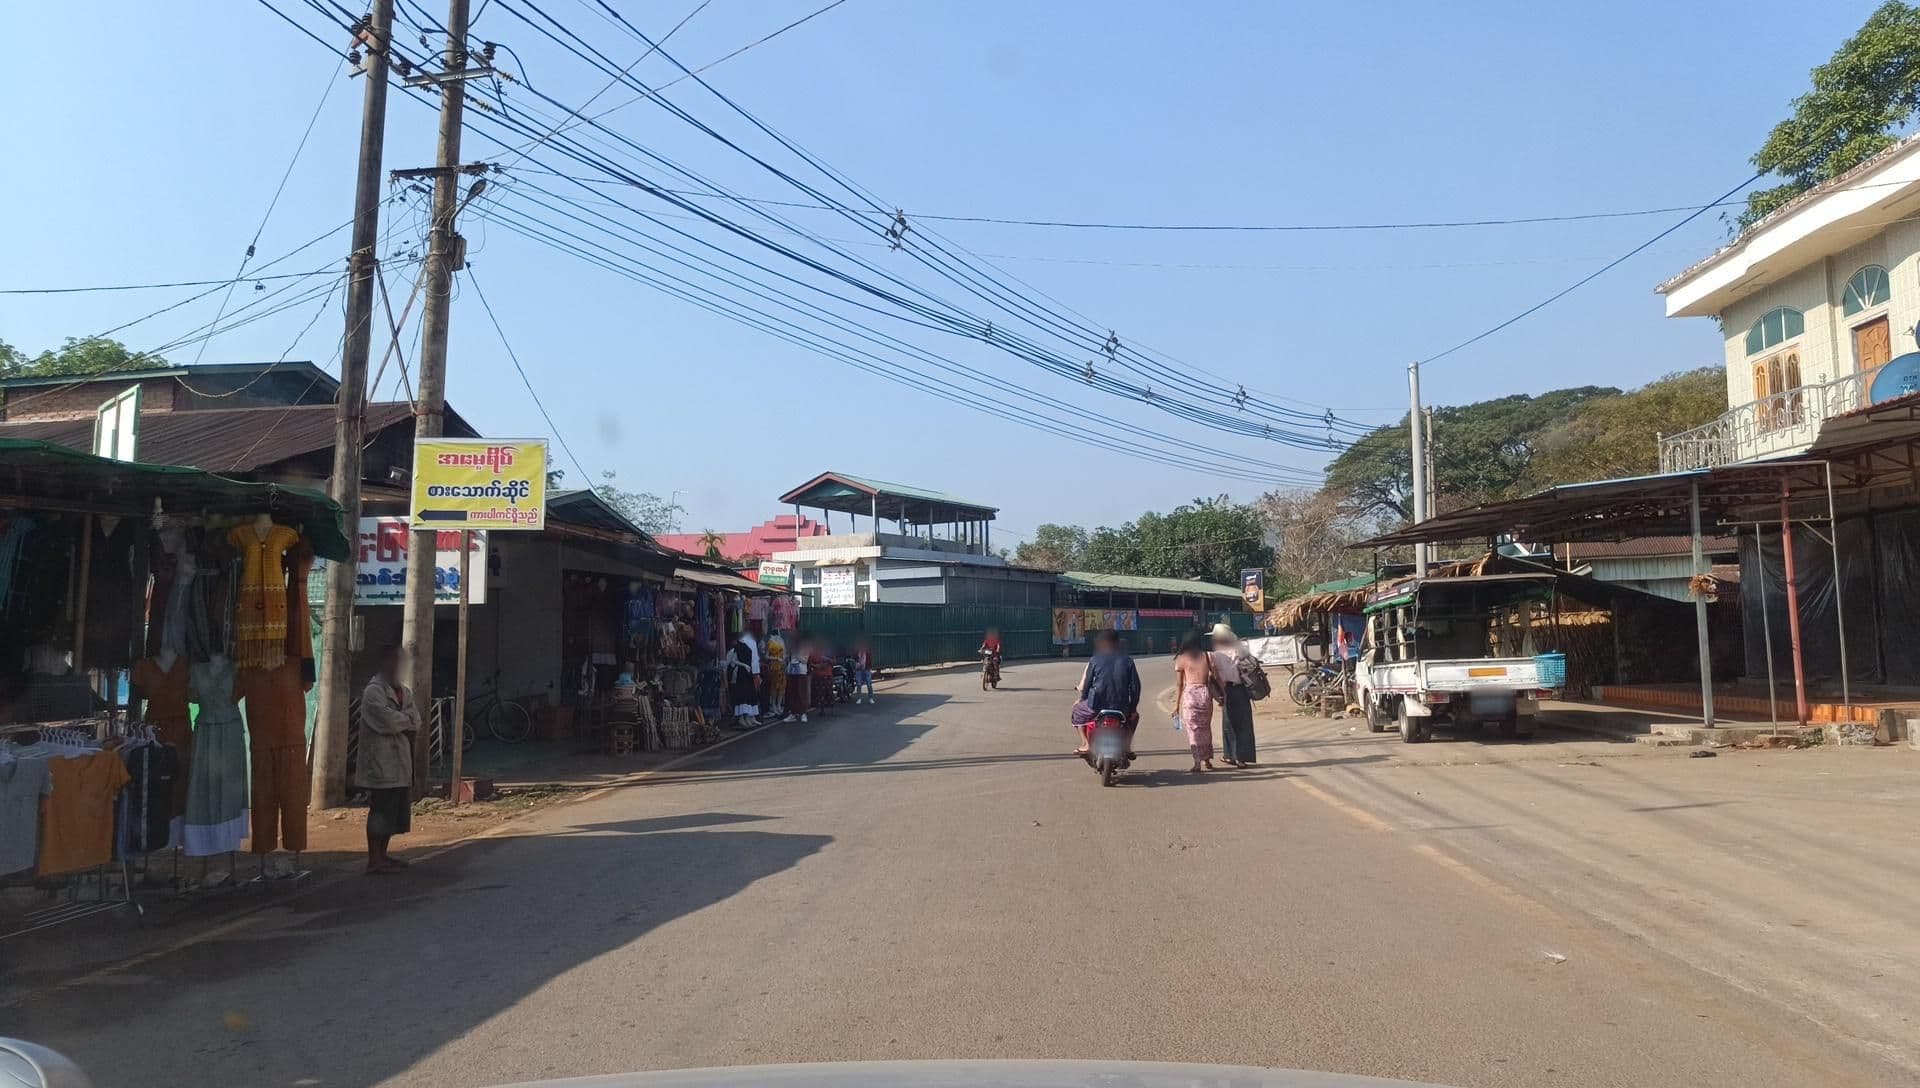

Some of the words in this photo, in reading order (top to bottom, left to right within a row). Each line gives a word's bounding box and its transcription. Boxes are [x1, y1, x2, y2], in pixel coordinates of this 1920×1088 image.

[428, 480, 530, 504] စားသောက်ဆိုင်
[470, 508, 538, 523] ကားပါကင်ရှိသည်
